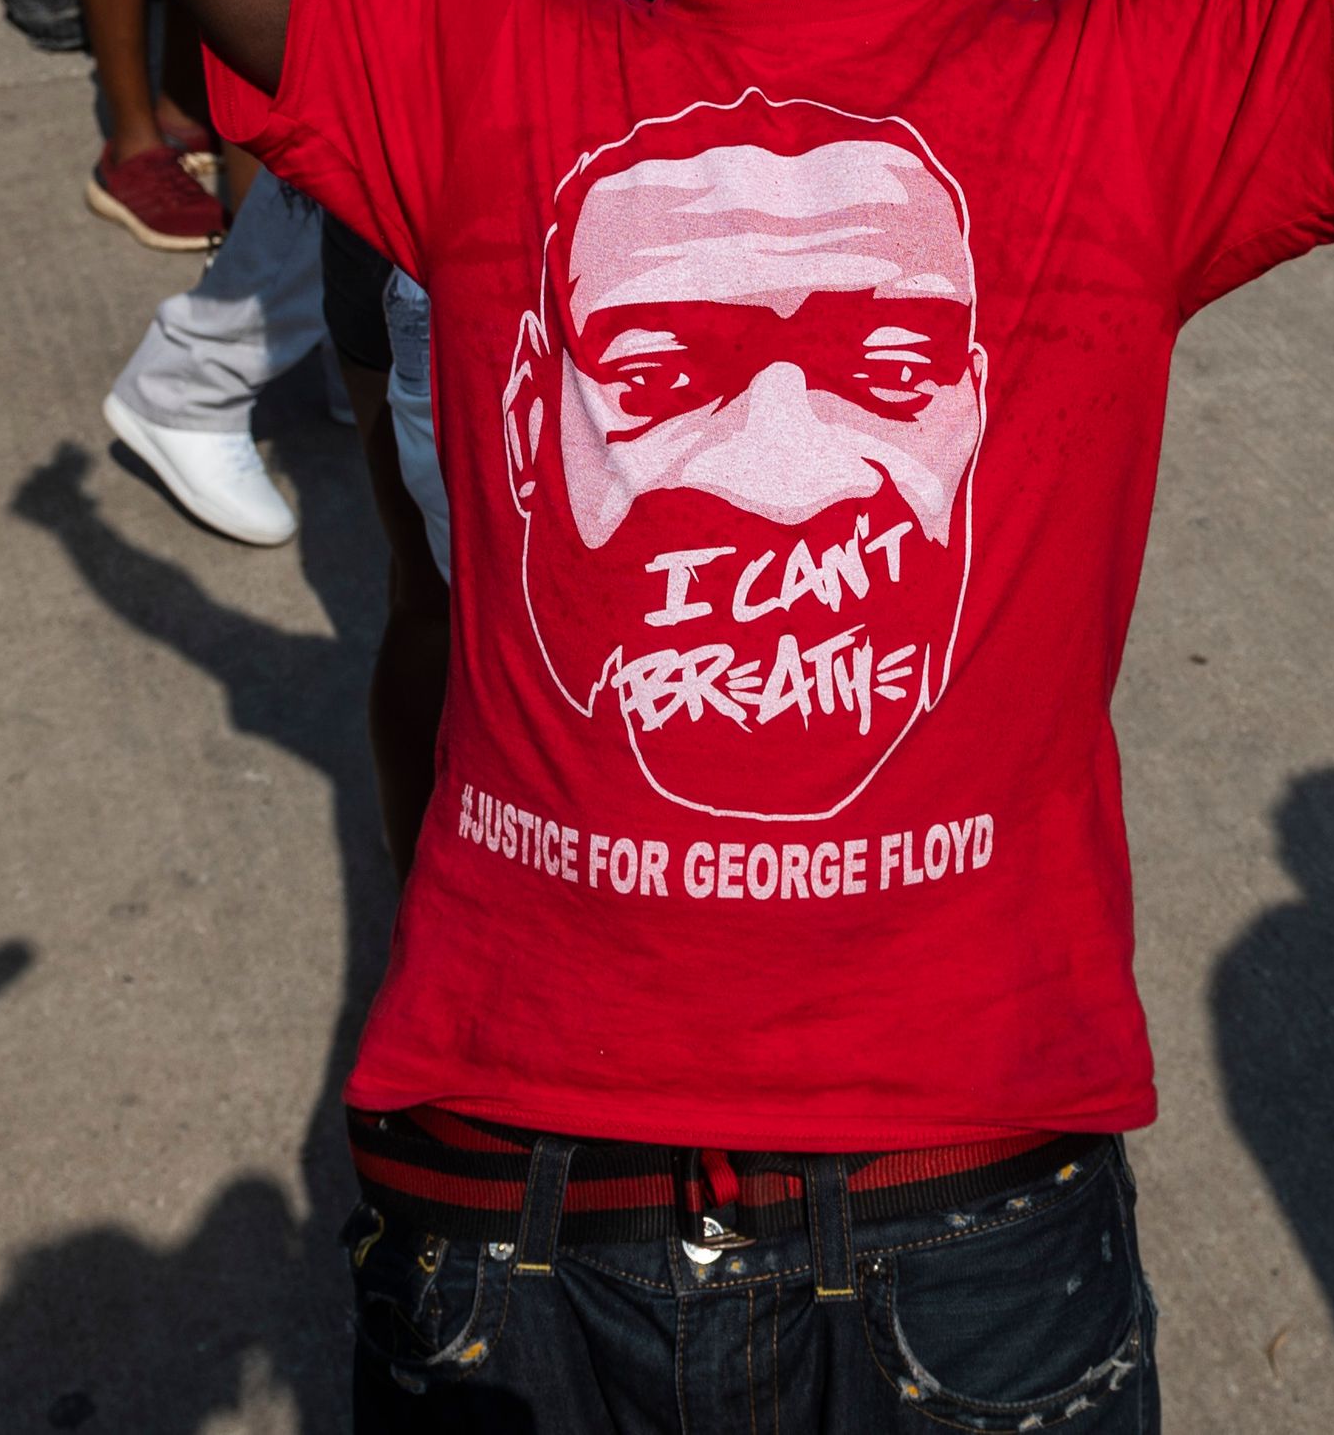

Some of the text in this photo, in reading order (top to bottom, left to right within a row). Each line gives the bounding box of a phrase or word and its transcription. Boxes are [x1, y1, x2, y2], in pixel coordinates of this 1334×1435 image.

[644, 513, 913, 627] I CAN'T
[611, 623, 916, 735] BREATHE
[458, 783, 995, 900] #JUSTICE FOR GEORGE FLOYD
